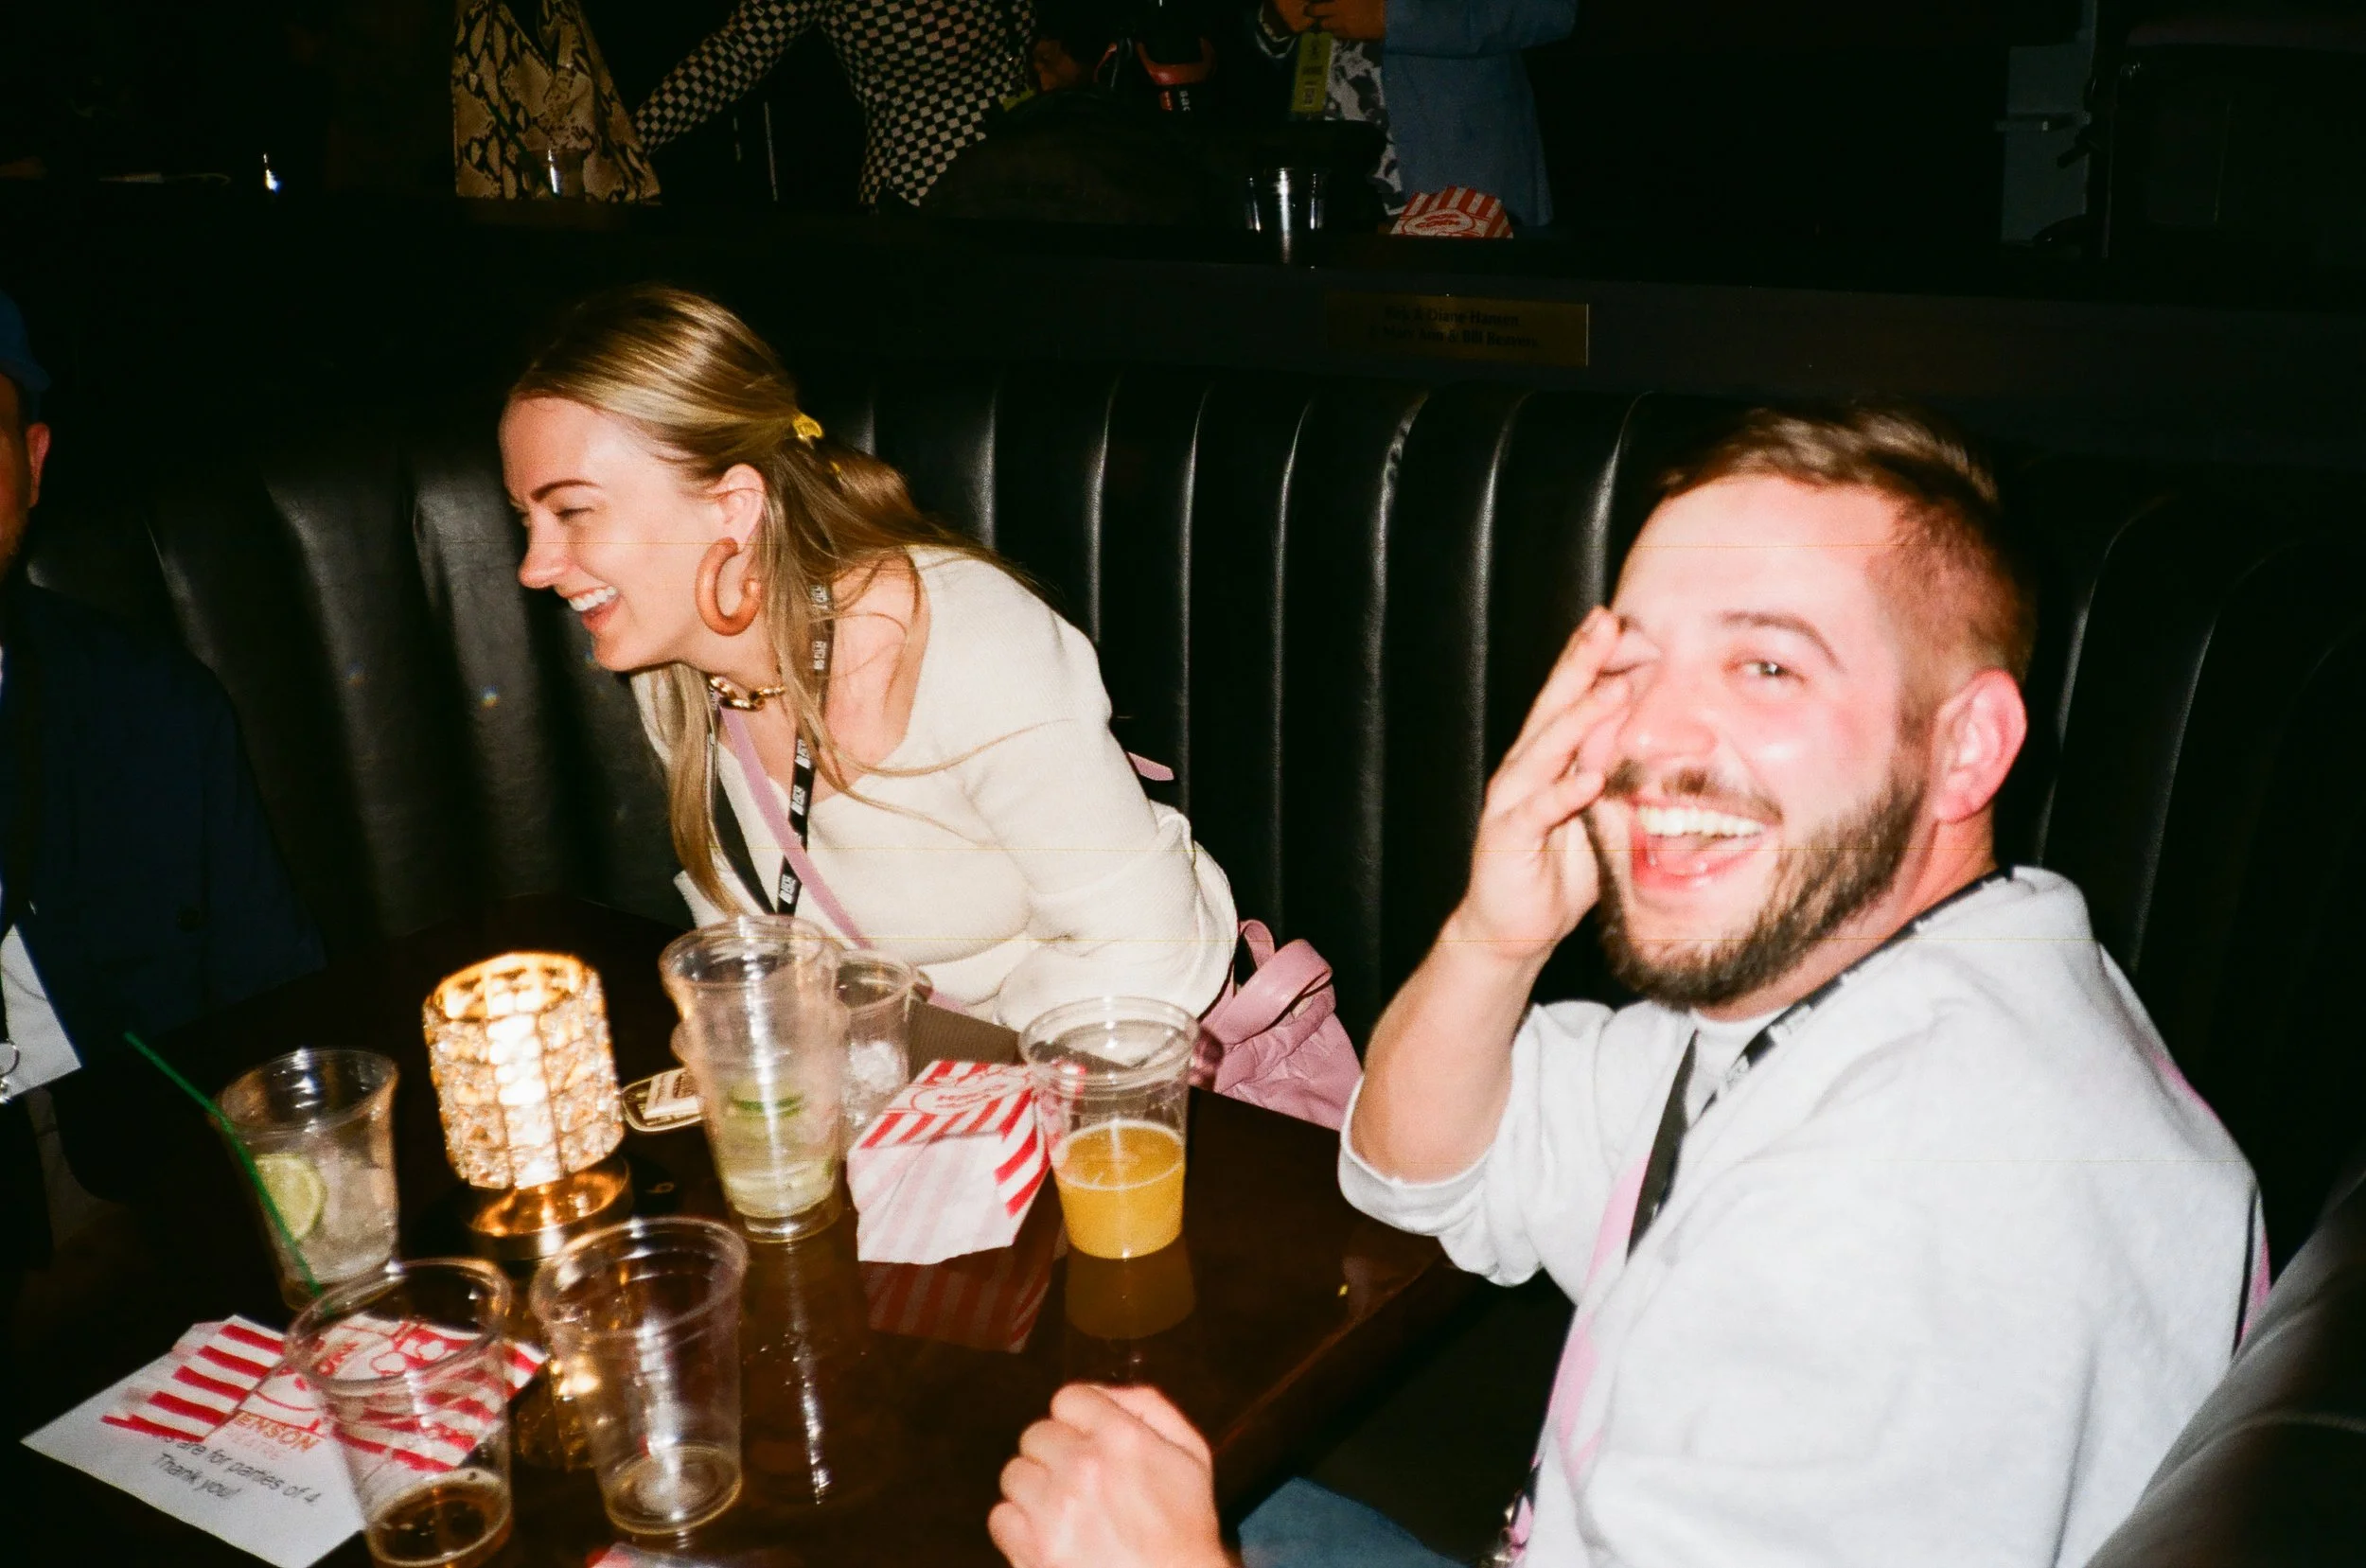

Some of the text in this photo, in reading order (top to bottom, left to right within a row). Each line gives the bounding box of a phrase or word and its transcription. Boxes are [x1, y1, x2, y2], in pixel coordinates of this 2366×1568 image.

[1470, 309, 1520, 326] Hansen
[153, 1453, 203, 1483] Thank
[207, 1449, 234, 1466] for
[222, 1462, 286, 1491] parties
[282, 1485, 311, 1500] of
